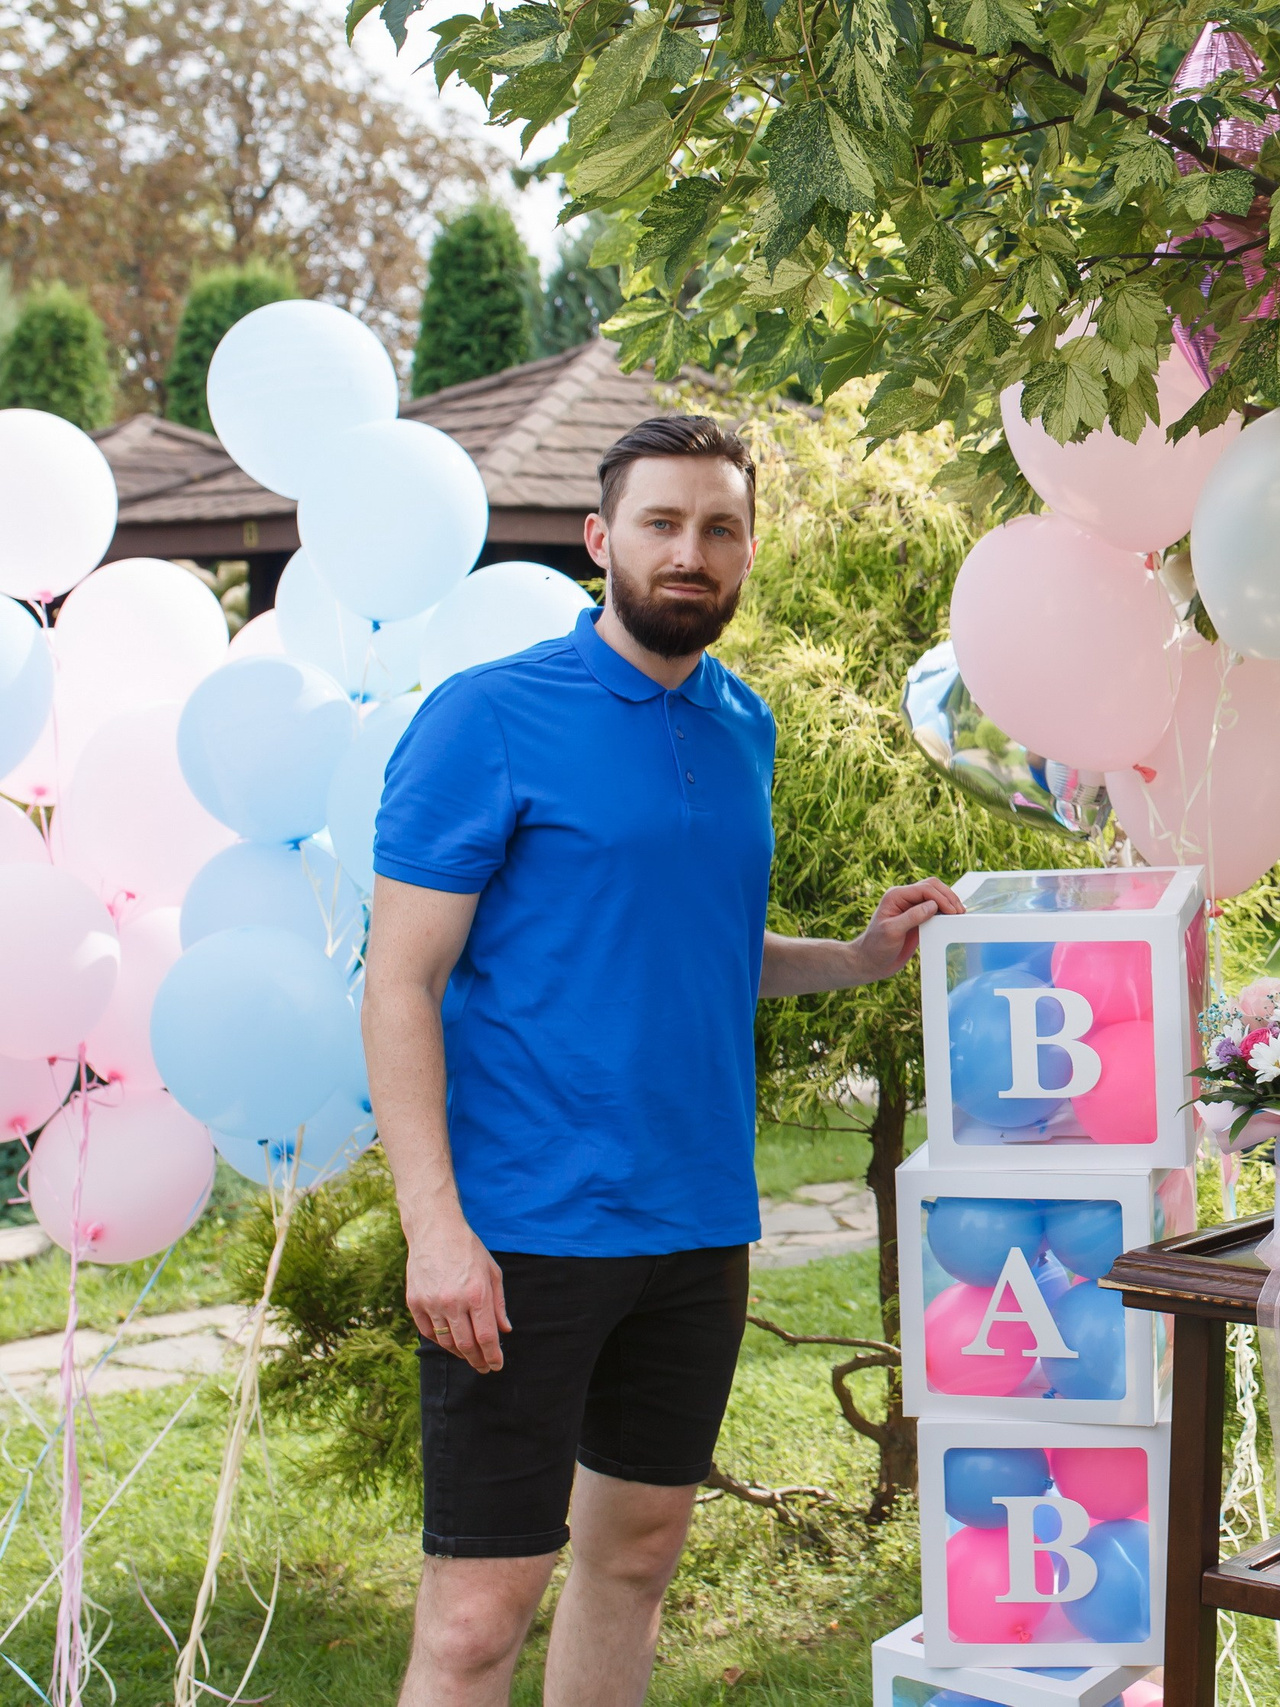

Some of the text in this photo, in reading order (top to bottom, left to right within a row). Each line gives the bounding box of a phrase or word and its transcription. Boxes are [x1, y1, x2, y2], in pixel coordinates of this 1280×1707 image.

[993, 987, 1102, 1099] B
[961, 1246, 1079, 1359] A
[991, 1496, 1098, 1603] B
